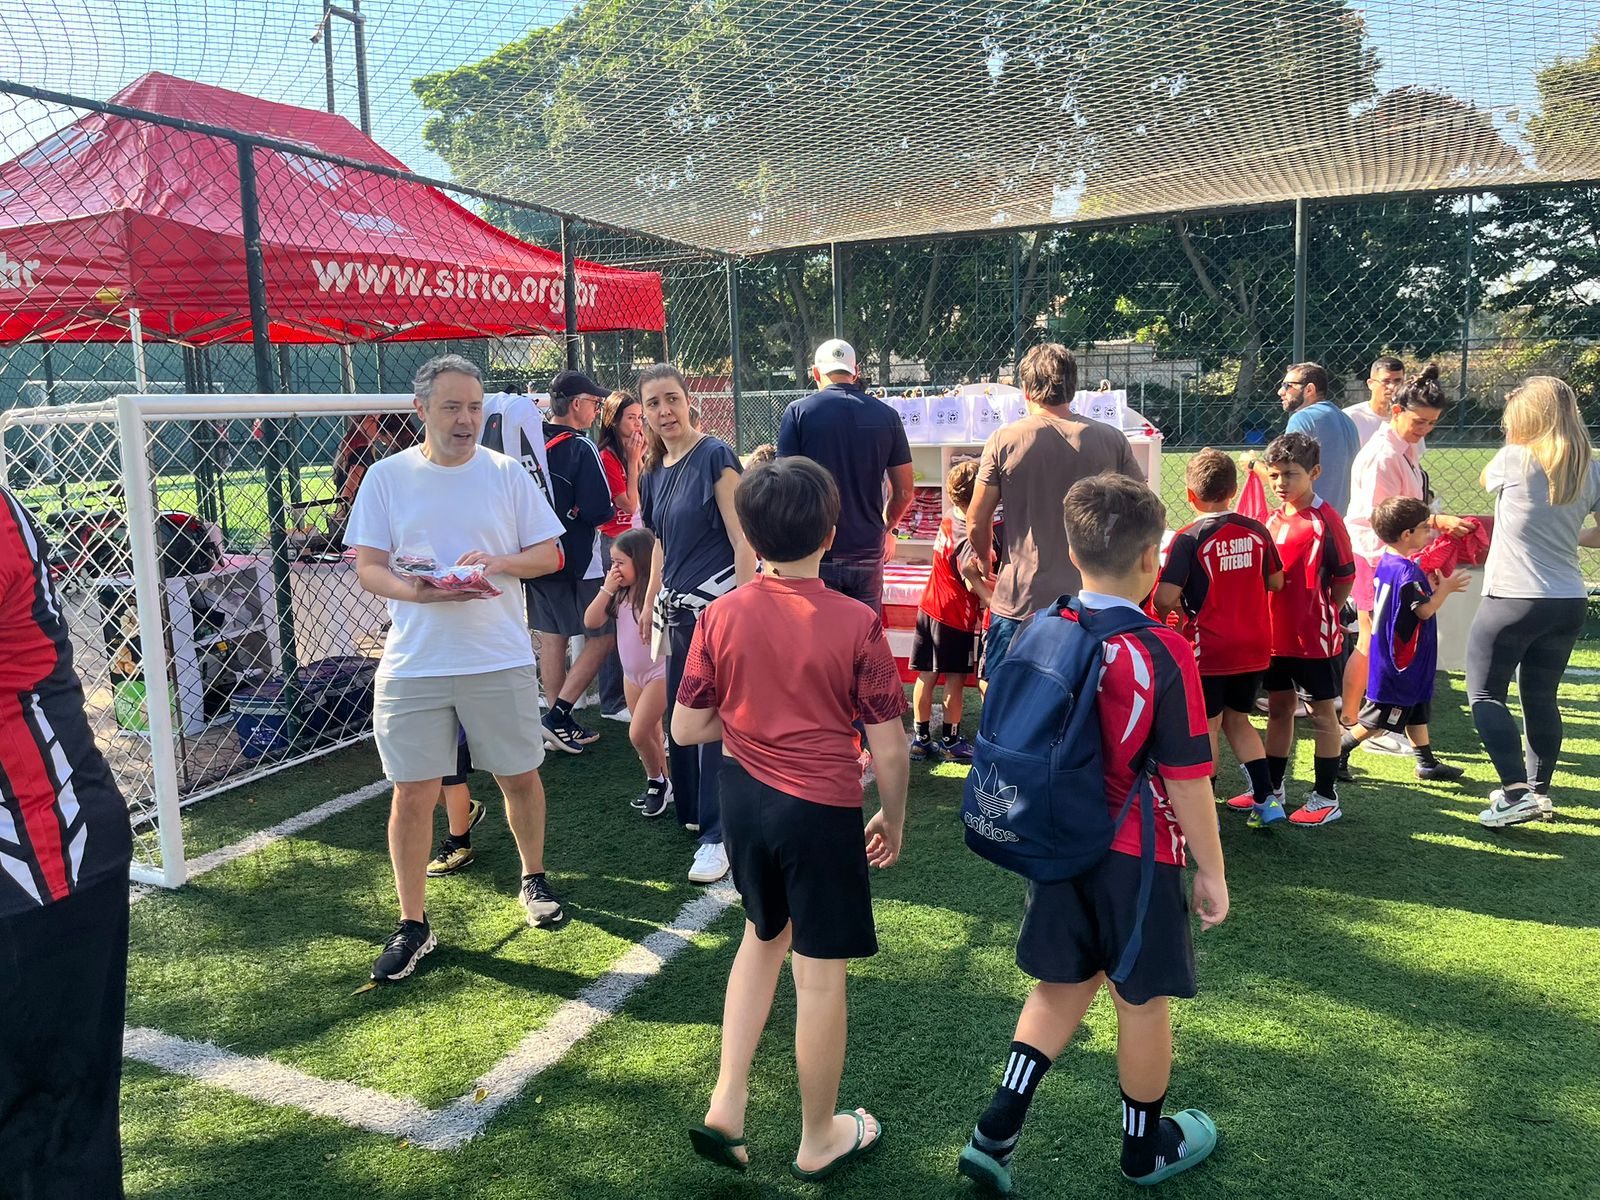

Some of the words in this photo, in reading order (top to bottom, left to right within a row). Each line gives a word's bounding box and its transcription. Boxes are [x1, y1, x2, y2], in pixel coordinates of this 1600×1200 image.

[311, 260, 598, 315] www.sirio.orgbr
[1229, 536, 1253, 555] SIRIO
[1219, 552, 1253, 572] FUTEBOL
[964, 811, 1020, 842] adidas
